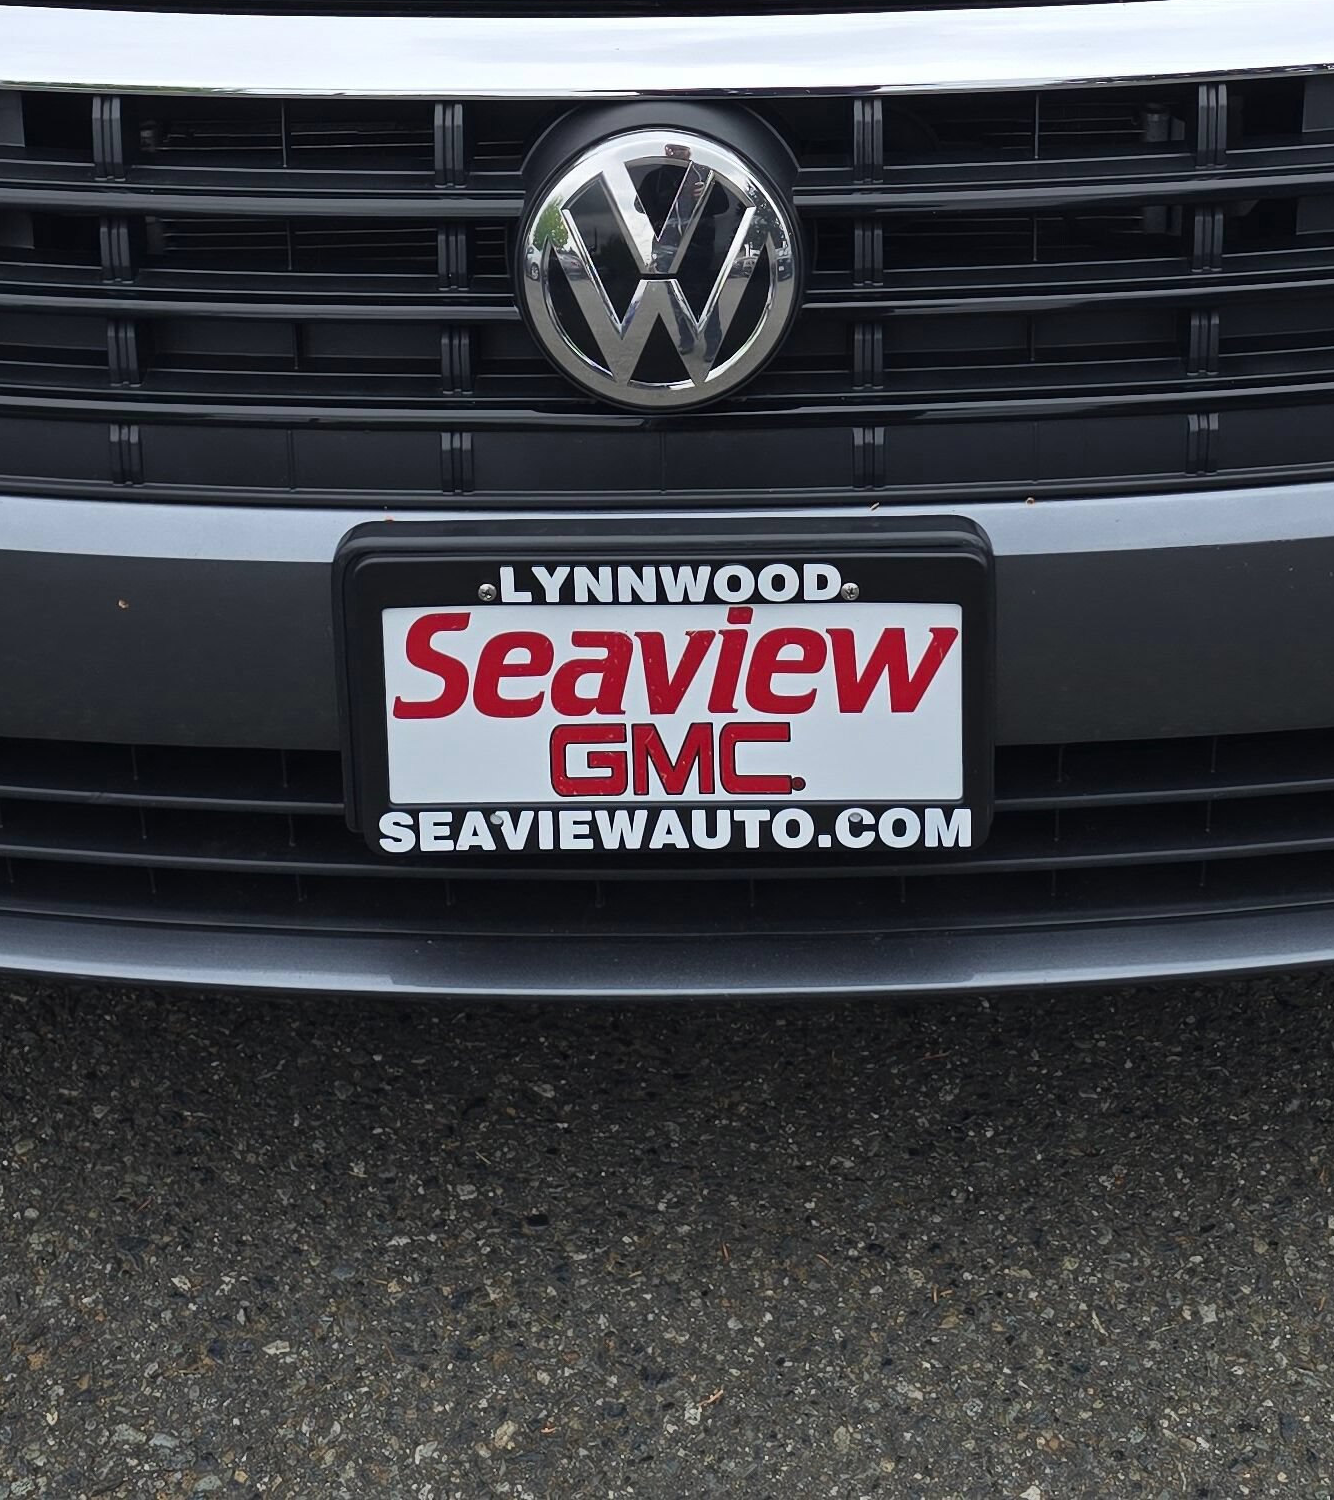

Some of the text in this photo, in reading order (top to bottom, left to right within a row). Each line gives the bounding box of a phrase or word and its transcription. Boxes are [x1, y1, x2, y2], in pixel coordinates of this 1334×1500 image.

[499, 563, 843, 603] LYNNWOOD
[392, 606, 959, 719] Seaview
[549, 722, 795, 797] GMC
[378, 806, 973, 852] SEAVIEWAUTO.COM
